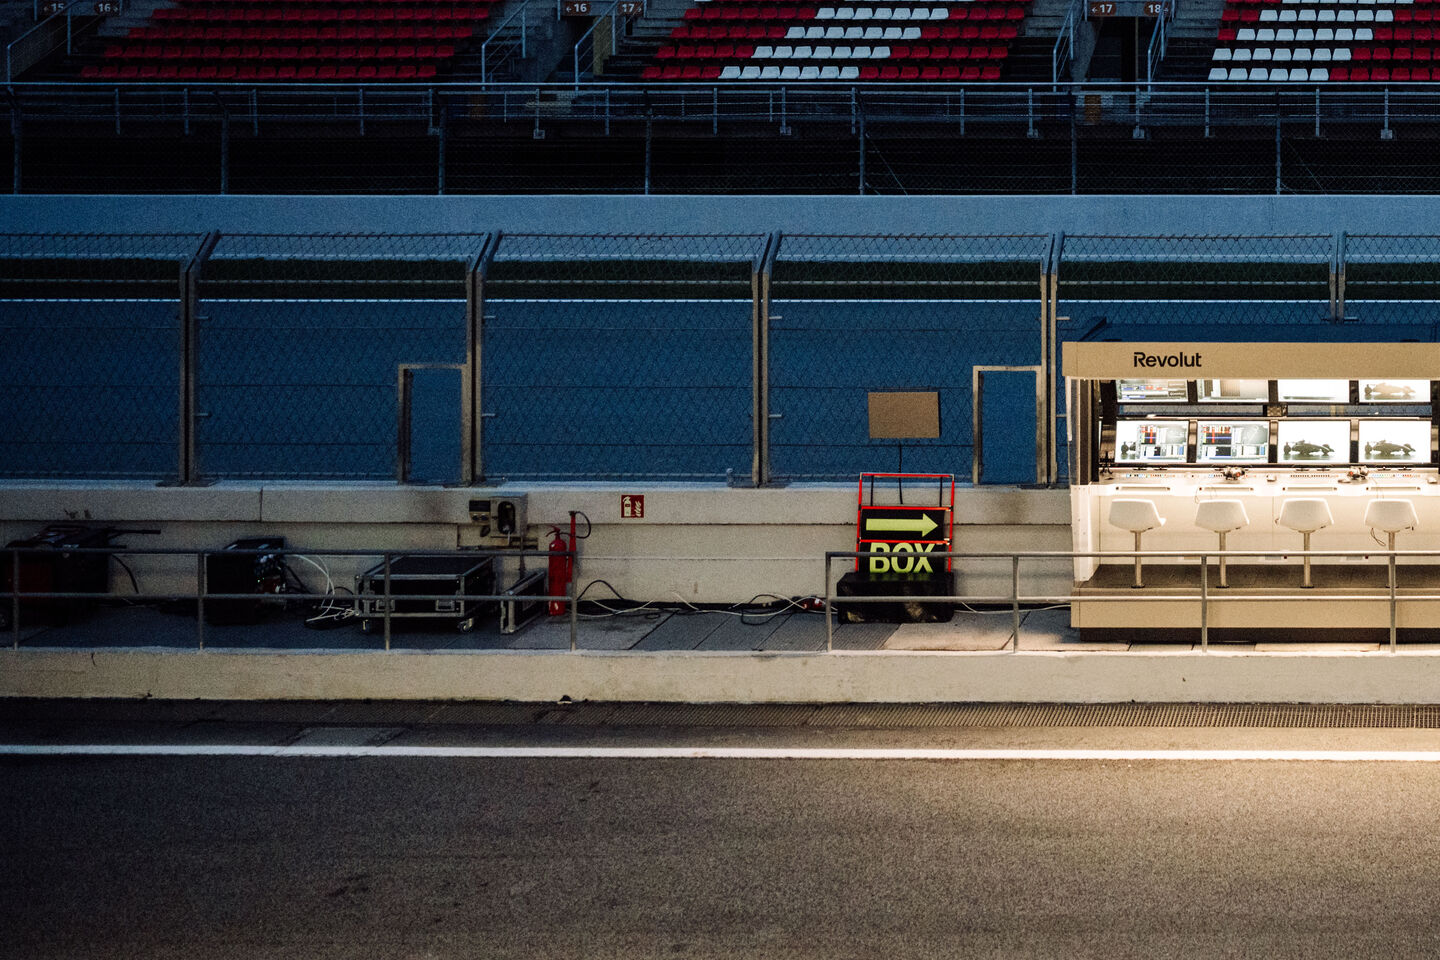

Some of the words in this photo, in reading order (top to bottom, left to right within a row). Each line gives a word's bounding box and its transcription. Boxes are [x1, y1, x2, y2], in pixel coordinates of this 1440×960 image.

[50, 3, 65, 13] 15
[98, 3, 111, 12] 16
[573, 3, 587, 12] 16
[622, 3, 635, 12] 17
[1099, 4, 1113, 13] 17
[1148, 4, 1161, 13] 18
[1133, 351, 1202, 367] Revolut
[869, 542, 935, 574] BOX
